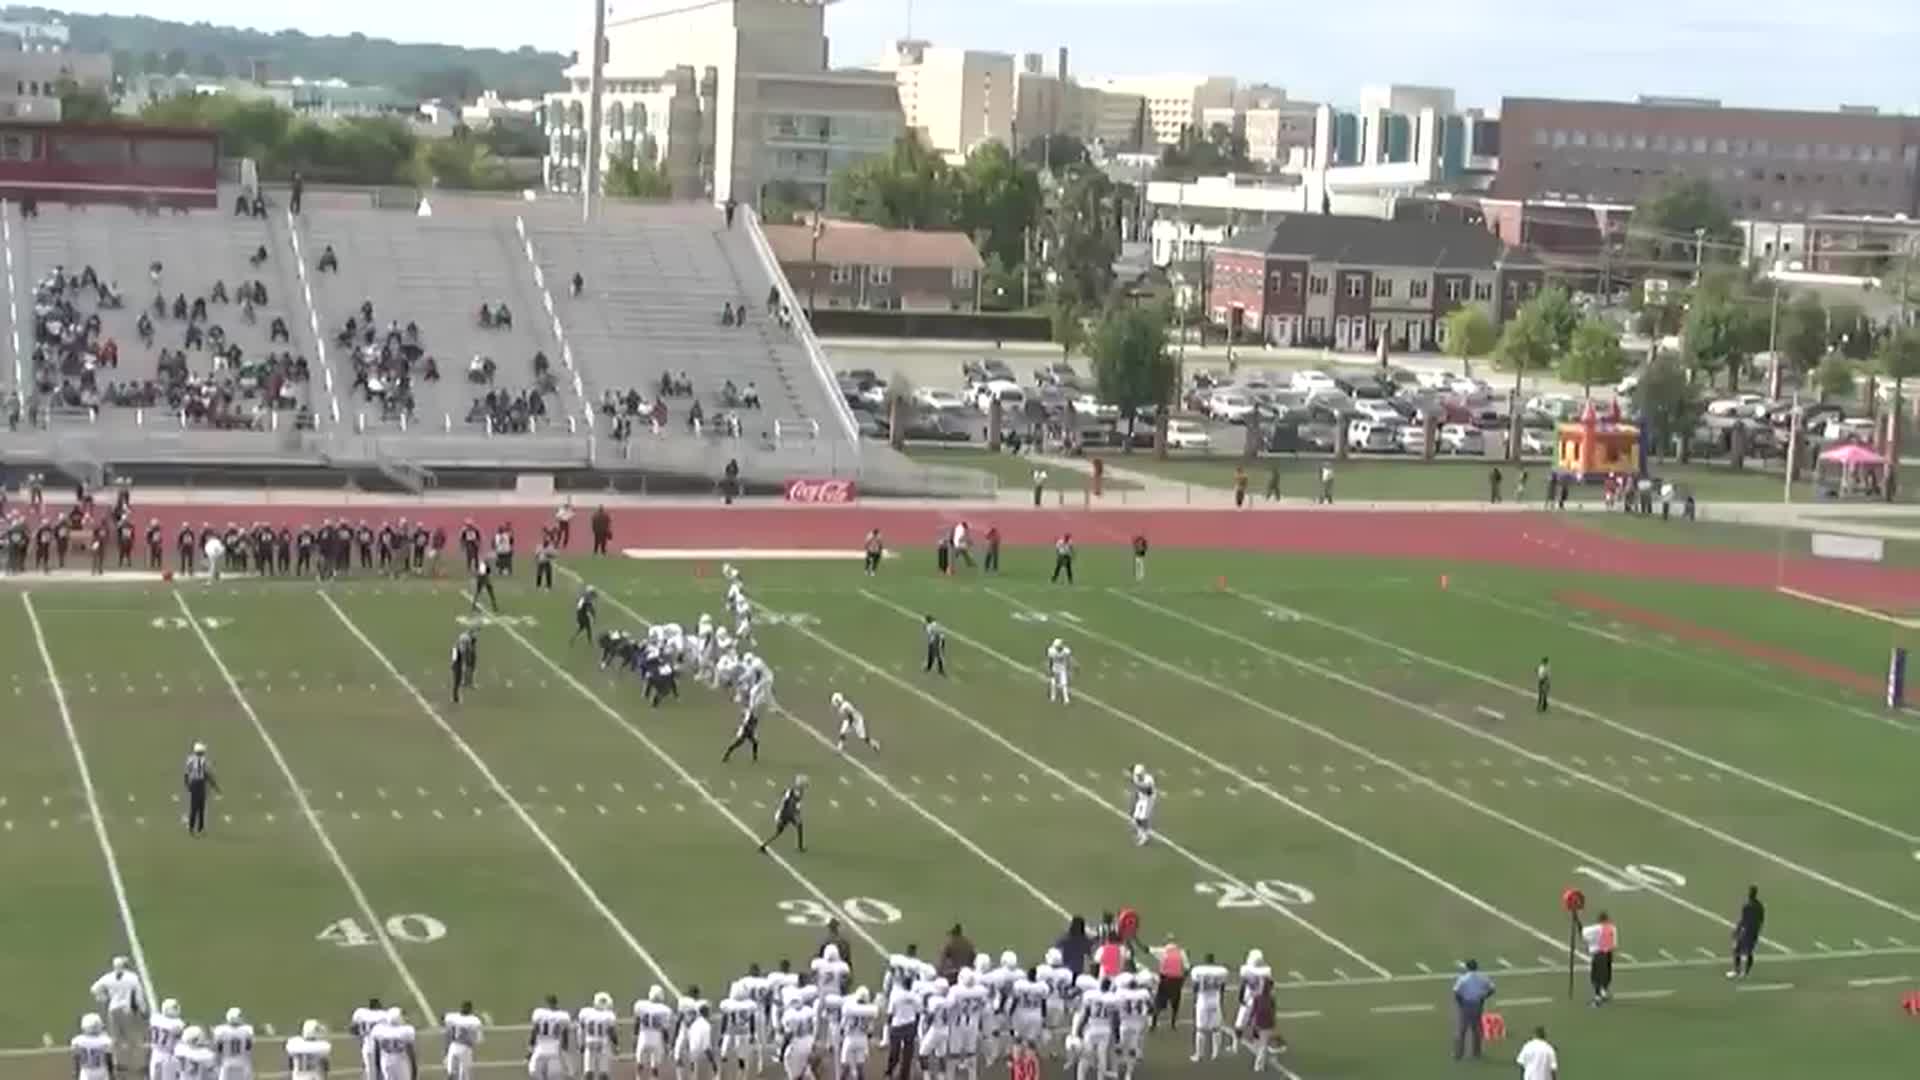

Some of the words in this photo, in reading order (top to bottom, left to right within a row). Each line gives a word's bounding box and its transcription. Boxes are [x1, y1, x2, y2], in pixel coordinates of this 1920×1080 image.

[1194, 880, 1315, 908] 20
[776, 896, 902, 926] 30
[314, 913, 446, 946] 40
